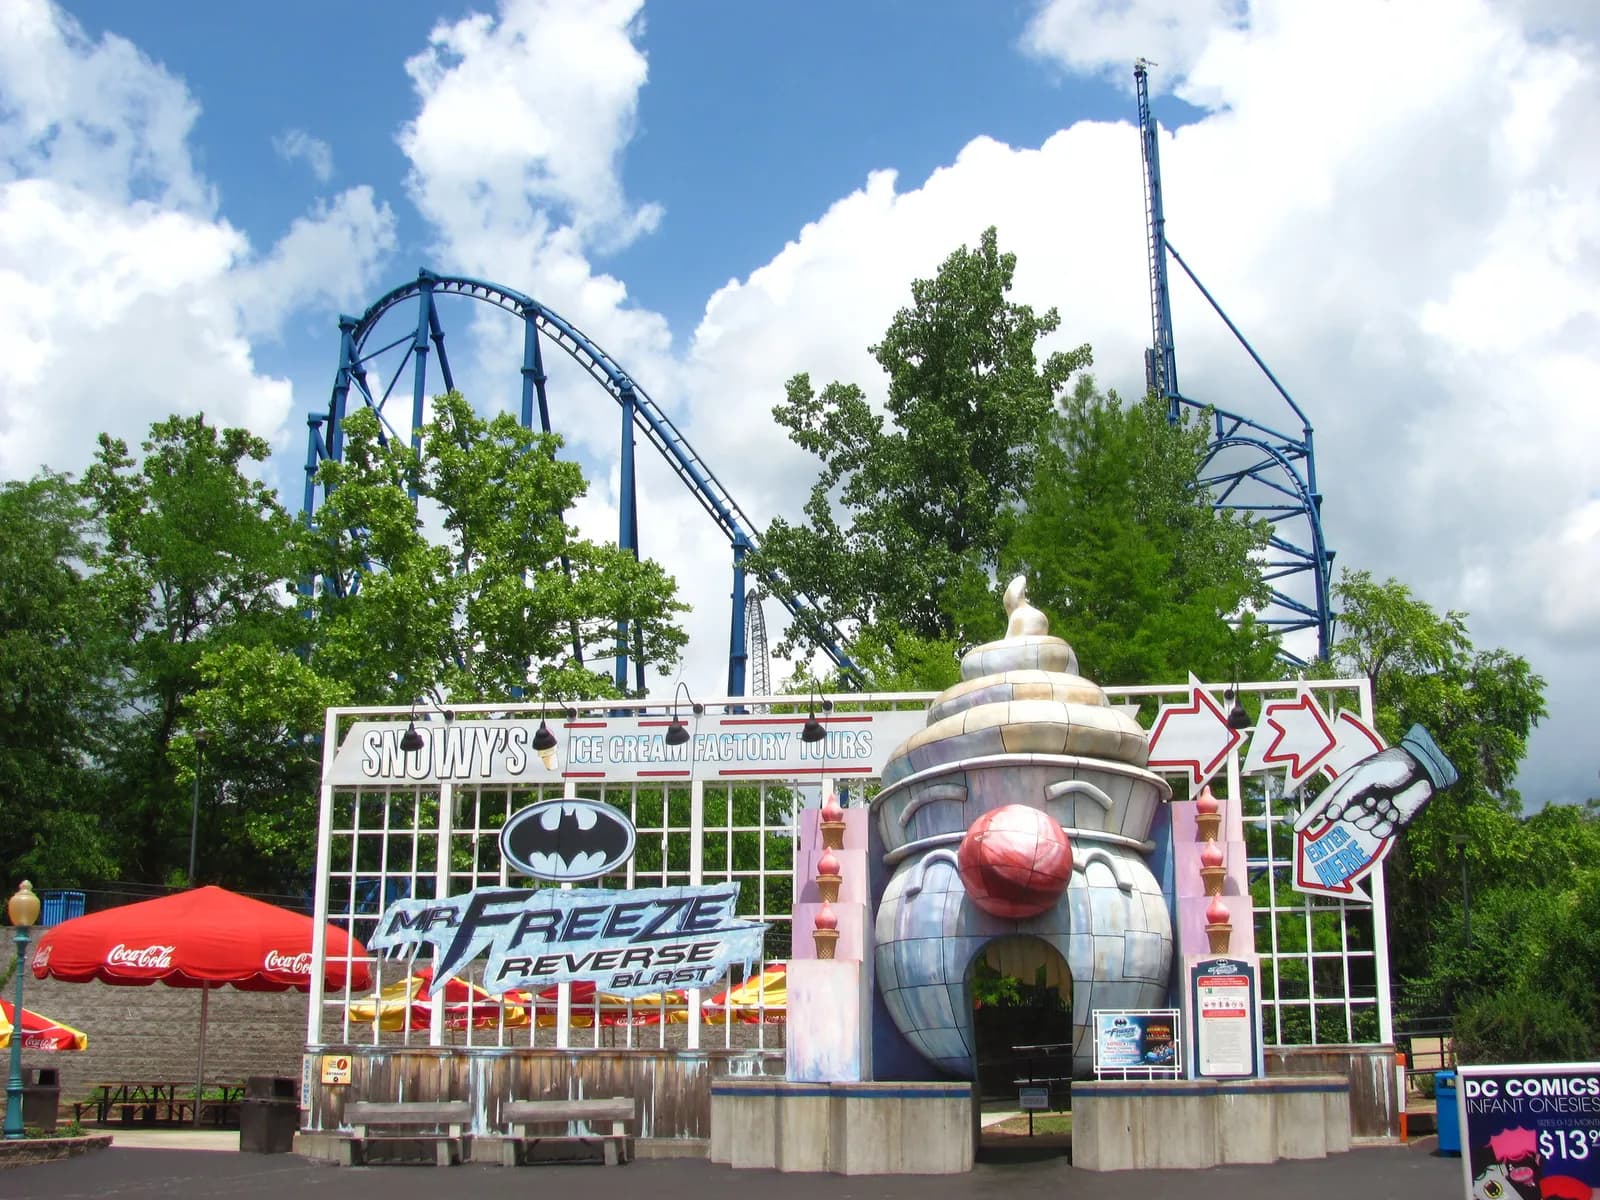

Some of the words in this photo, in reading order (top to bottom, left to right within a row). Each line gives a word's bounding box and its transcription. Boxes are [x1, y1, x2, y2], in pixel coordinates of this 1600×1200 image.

[362, 727, 528, 780] SNOWY'S
[569, 735, 604, 764] ICE
[608, 733, 688, 763] CREAM
[693, 731, 791, 762] FACTORY
[797, 730, 873, 761] TOURS
[1304, 825, 1351, 864] ENTER
[1313, 839, 1372, 888] HERE
[431, 889, 740, 987] FREEZE
[264, 949, 312, 975] Coca-Co
[496, 941, 721, 982] REVERSE
[609, 965, 716, 989] BLAST
[1465, 1080, 1499, 1097] DC
[1505, 1077, 1600, 1097] COMICS
[1467, 1098, 1524, 1113] INFANT
[1529, 1096, 1600, 1113] ONESIES
